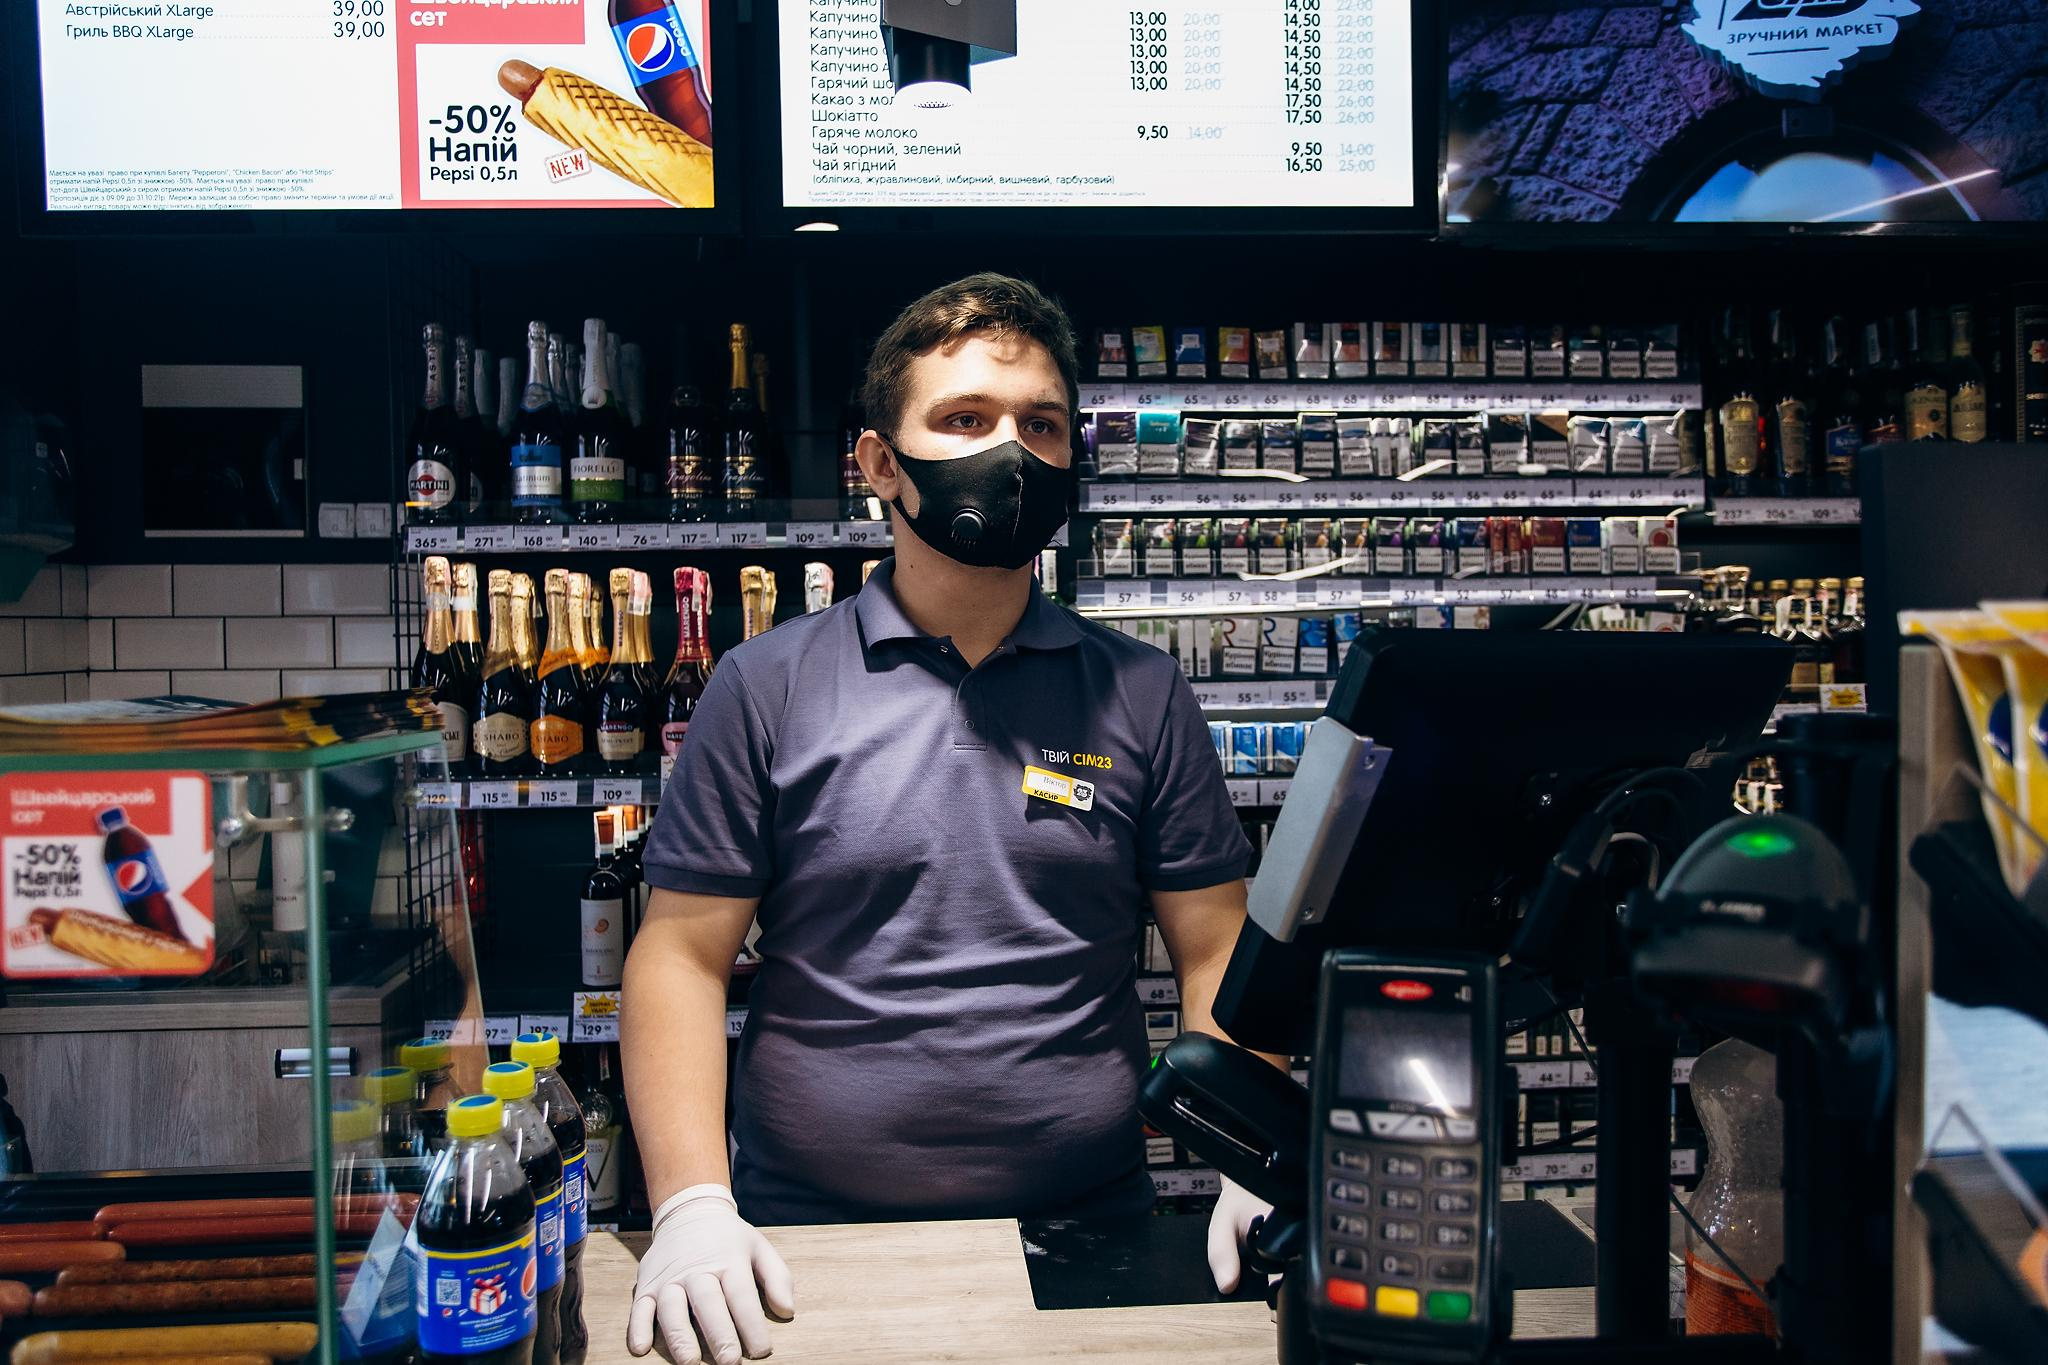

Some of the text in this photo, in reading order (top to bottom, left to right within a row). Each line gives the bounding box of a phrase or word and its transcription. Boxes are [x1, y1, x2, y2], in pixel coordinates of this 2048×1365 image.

[66, 3, 213, 19] Австрійський XLarge
[334, 0, 383, 18] 39,00
[410, 11, 447, 26] сет
[810, 11, 877, 25] Капучино
[1130, 12, 1219, 27] 13,00 20,00
[1284, 14, 1320, 28] 14,50
[67, 25, 194, 40] Гриль BBQ XLarge
[334, 22, 385, 39] 39,00
[666, 16, 691, 56] pepsi
[810, 27, 877, 42] Капучино
[1130, 28, 1220, 44] 13,00 20,00
[1727, 22, 1883, 44] ЗРУЧНИЙ МАРКЕТ
[1284, 30, 1320, 45] 14,50
[811, 44, 878, 58] Капучино
[1130, 45, 1220, 60] 13,00 20,00
[1285, 46, 1321, 61] 14,50
[811, 60, 878, 75] Капучино
[1131, 61, 1220, 76] 13,00 20,00
[1285, 62, 1321, 77] 14,50
[811, 76, 868, 91] Гарячий
[1131, 77, 1220, 93] 13,00 20,00
[1285, 79, 1321, 93] 14,50
[812, 93, 854, 105] Какао
[859, 96, 864, 105] з
[1285, 94, 1321, 109] 17,50
[429, 106, 516, 133] -50%
[812, 110, 878, 122] Шокіатто
[1286, 110, 1322, 125] 17,50
[812, 126, 918, 140] Гаряче молоко
[1138, 126, 1168, 141] 9,50
[429, 137, 517, 162] Напій
[812, 142, 962, 158] Чай чорний, зелений
[1292, 143, 1322, 157] 9,50
[550, 153, 584, 178] NEW
[813, 158, 896, 172] Чай ягідний
[1286, 159, 1322, 173] 16,50
[430, 166, 517, 184] Pepsi 0,5л
[1092, 395, 1105, 404] 65
[1138, 395, 1151, 404] 65
[1185, 395, 1198, 404] 65
[1225, 395, 1239, 404] 65
[1265, 395, 1278, 404] 65
[410, 480, 449, 491] MARTINI
[1103, 495, 1117, 504] 55
[1150, 495, 1164, 504] 55
[1197, 494, 1210, 503] 56
[1233, 494, 1246, 502] 56
[1279, 494, 1291, 502] 55
[1314, 493, 1327, 501] 55
[1350, 492, 1363, 500] 56
[415, 538, 437, 548] 365
[474, 537, 494, 546] 271
[524, 536, 542, 546] 168
[579, 536, 598, 545] 140
[634, 536, 647, 545] 76
[682, 534, 697, 544] 117
[731, 534, 747, 544] 117
[796, 534, 814, 542] 109
[849, 533, 867, 542] 109
[1119, 593, 1132, 602] 57
[1181, 592, 1194, 602] 56
[1229, 592, 1241, 601] 57
[1264, 592, 1277, 601] 58
[1238, 693, 1251, 702] 55
[1284, 692, 1297, 701] 55
[483, 733, 520, 742] SHABO
[1042, 749, 1112, 769] ТВІЙ СІМ23
[482, 793, 498, 802] 115
[541, 792, 557, 801] 115
[603, 790, 622, 800] 109
[1034, 789, 1058, 800] КАСИР
[1273, 792, 1286, 800] 65
[16, 844, 81, 864] -50%
[14, 866, 82, 885] Напій
[1151, 989, 1164, 999] 68
[583, 1025, 602, 1035] 129
[1508, 1167, 1521, 1176] 70
[1545, 1165, 1558, 1174] 70
[1156, 1181, 1168, 1191] 58
[1191, 1180, 1205, 1189] 59
